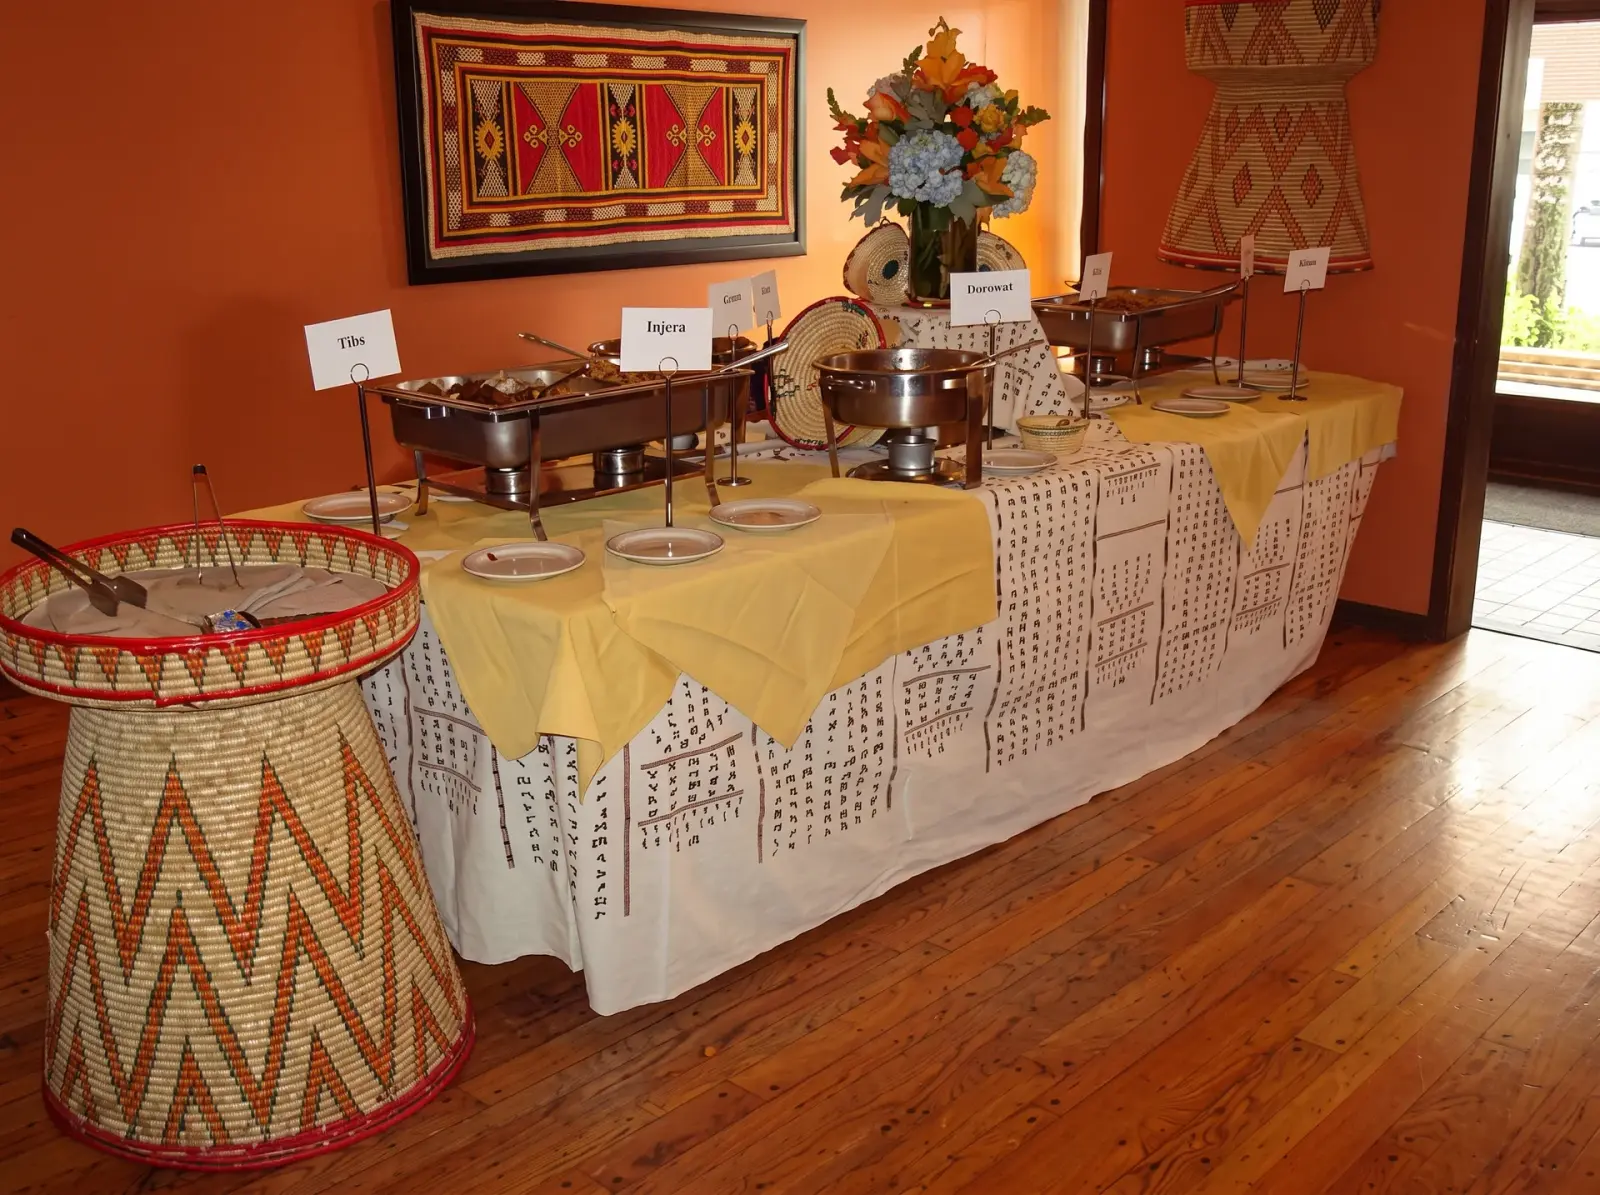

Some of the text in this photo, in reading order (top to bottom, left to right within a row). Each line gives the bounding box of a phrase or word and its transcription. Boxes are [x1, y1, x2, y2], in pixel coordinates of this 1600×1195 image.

[967, 282, 1014, 294] Dorowat
[646, 320, 687, 336] Injera
[337, 335, 366, 350] Tibs
